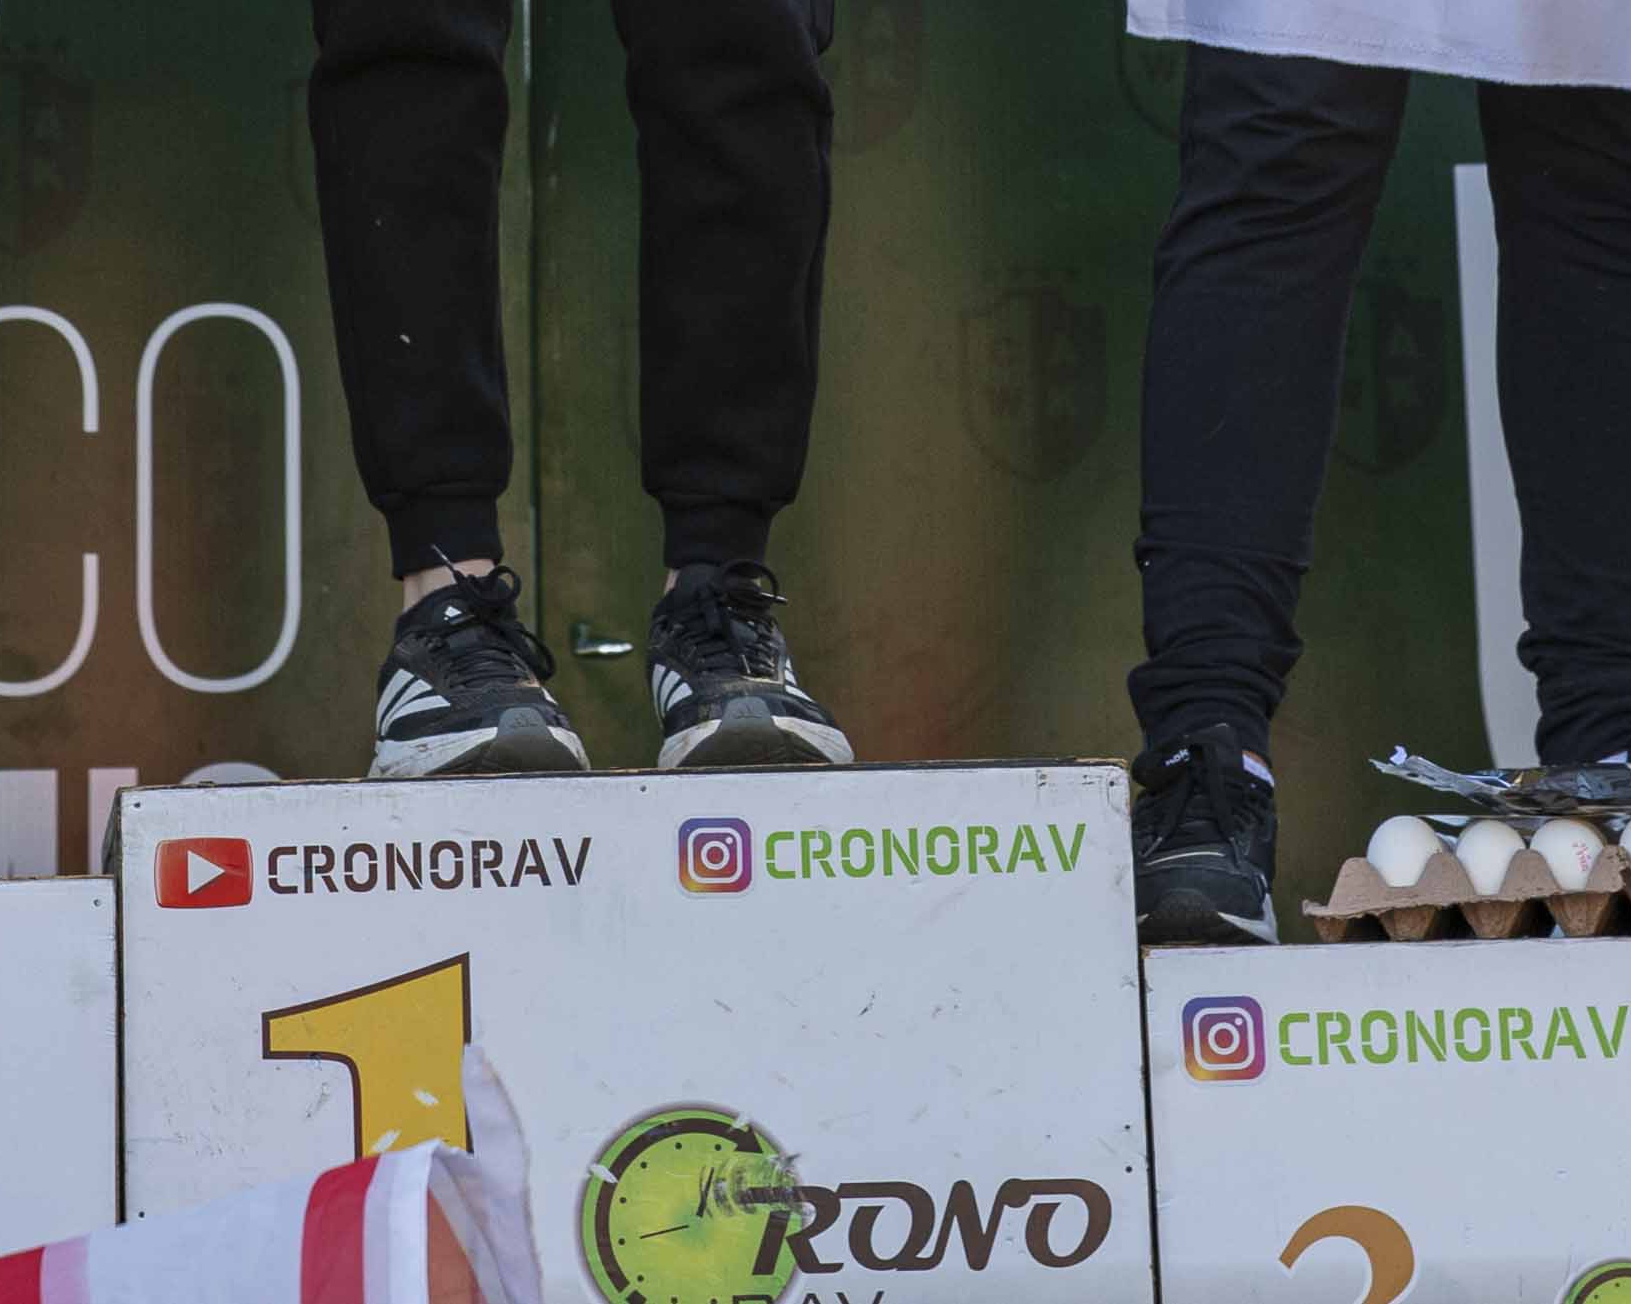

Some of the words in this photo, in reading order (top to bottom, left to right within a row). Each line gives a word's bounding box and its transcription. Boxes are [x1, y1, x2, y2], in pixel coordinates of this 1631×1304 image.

[265, 836, 593, 897] CRONORAV
[764, 821, 1089, 881] CRONORAV
[1278, 1003, 1631, 1068] CRONORAV
